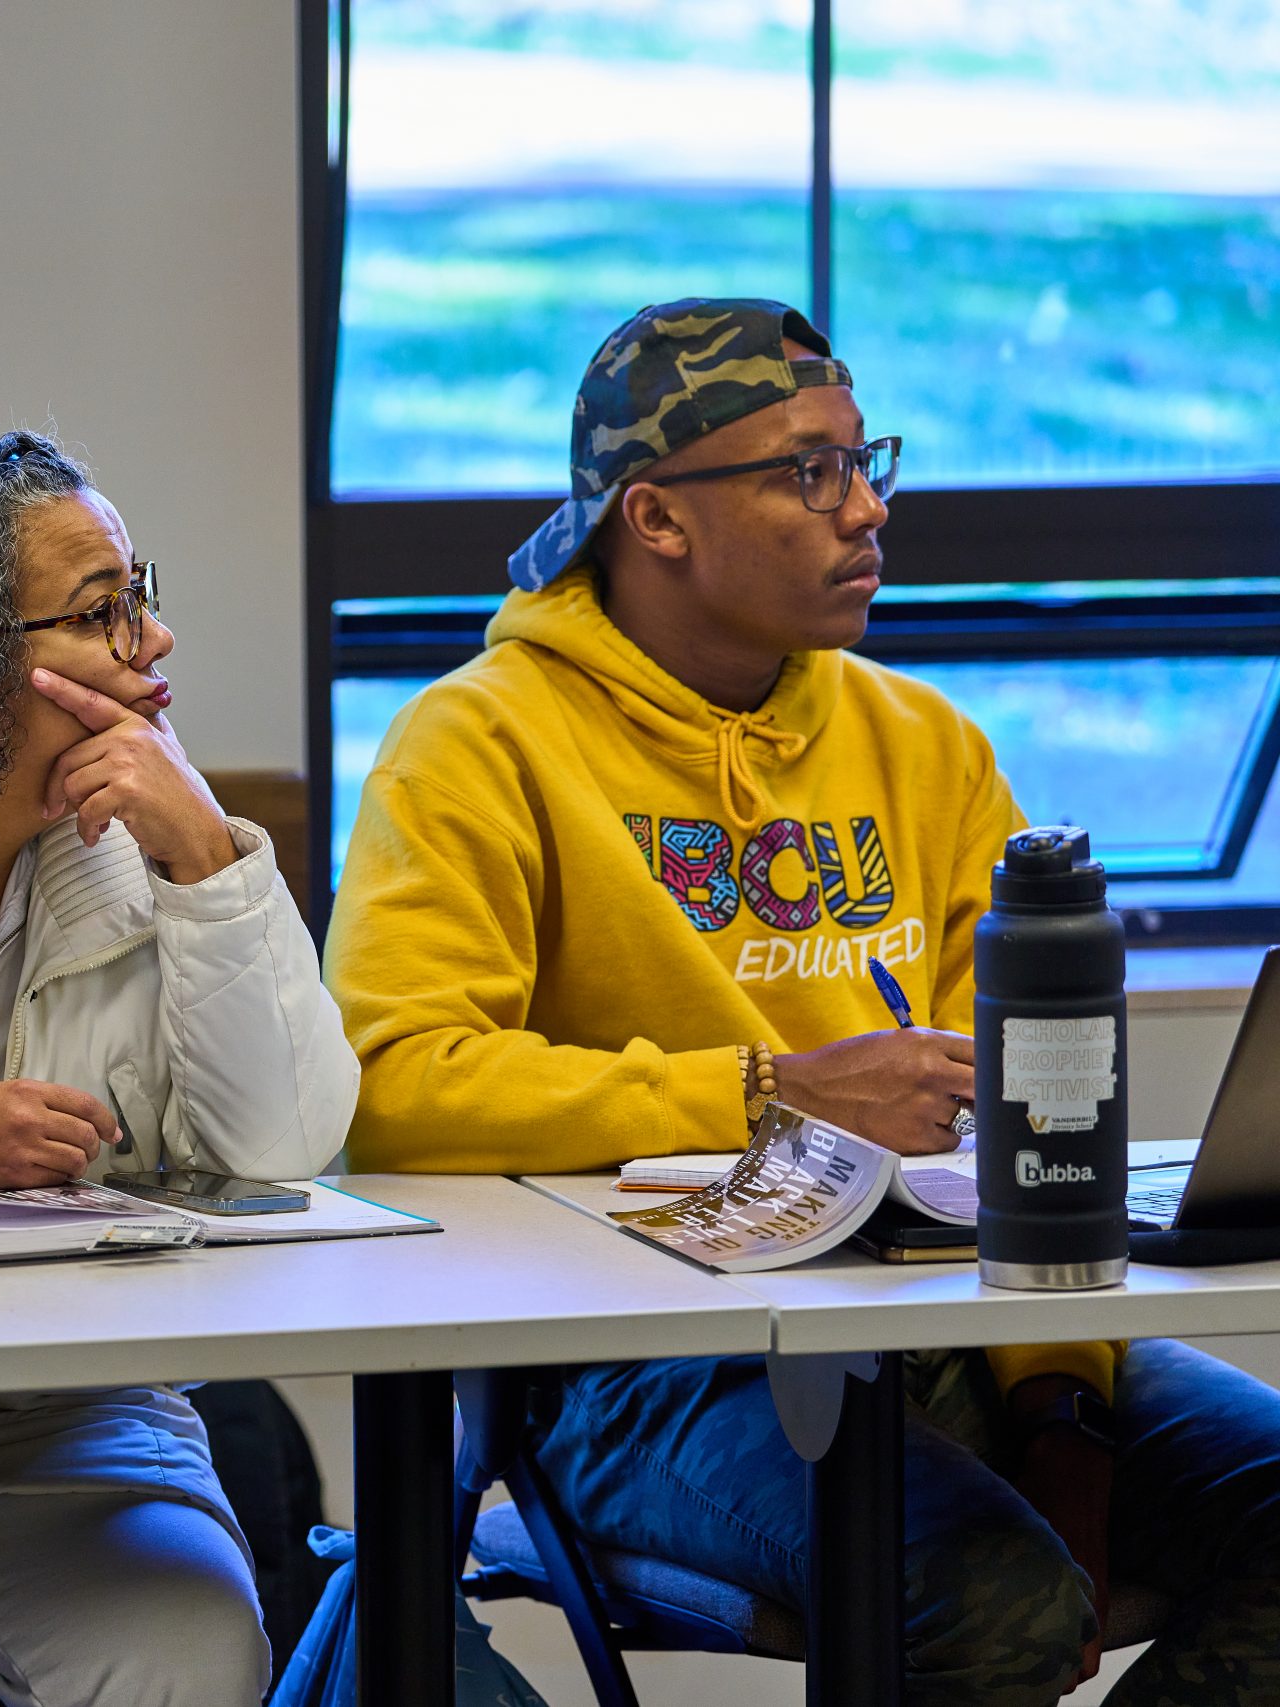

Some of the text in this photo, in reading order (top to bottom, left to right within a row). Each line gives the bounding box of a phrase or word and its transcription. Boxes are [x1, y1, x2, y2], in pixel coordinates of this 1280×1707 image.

[1004, 1019, 1116, 1042] SCHOLAR
[1004, 1047, 1115, 1071] PROPHET
[1004, 1076, 1116, 1101] ACTIVIST
[652, 1127, 837, 1246] BLACK LIVES
[672, 1156, 793, 1227] MATTER
[706, 1149, 758, 1193] CHRISTOPHER
[699, 1155, 856, 1253] MAKING OF
